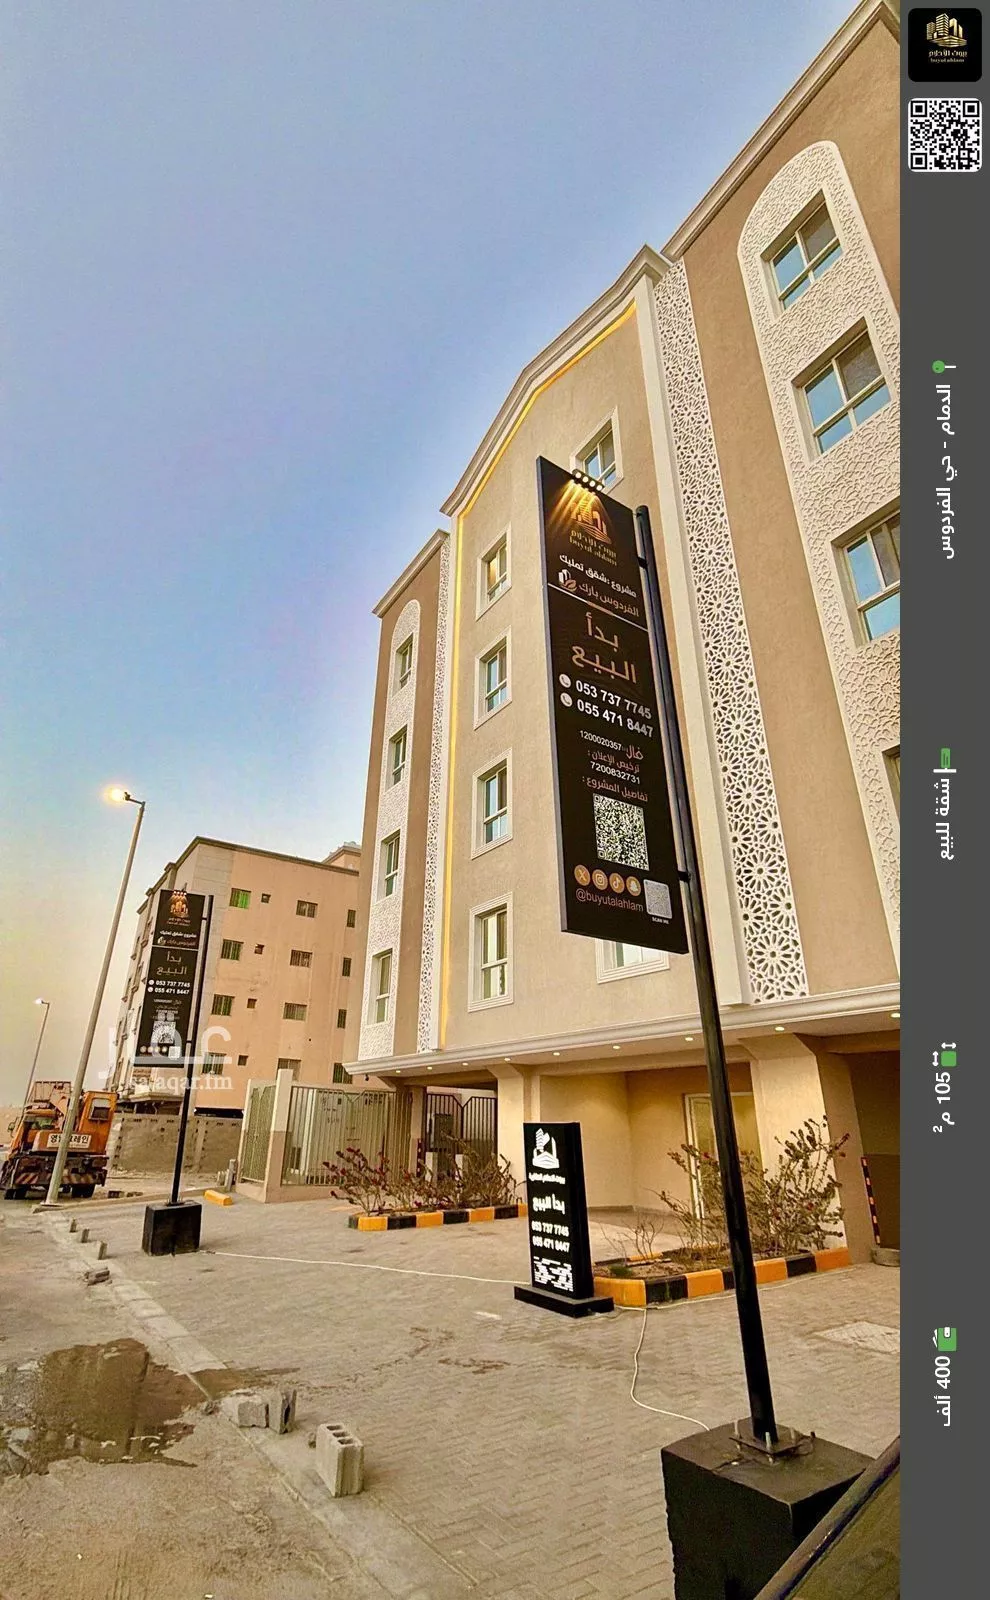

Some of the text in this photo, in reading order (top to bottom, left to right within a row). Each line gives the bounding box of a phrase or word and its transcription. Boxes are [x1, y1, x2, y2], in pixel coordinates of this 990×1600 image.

[559, 554, 584, 571] تمليك
[578, 582, 639, 617] الفردوس بارك
[611, 578, 637, 598] مشروع
[585, 611, 619, 652] بدأ
[571, 644, 637, 684] البيع
[575, 680, 652, 719] 053 737 7745
[577, 699, 653, 738] 055 471 8447
[579, 730, 622, 751] 1200020357
[586, 777, 620, 793] المشروع
[590, 761, 641, 785] 7200832731
[575, 887, 644, 913] @buyutalahlam
[156, 966, 187, 977] البيع
